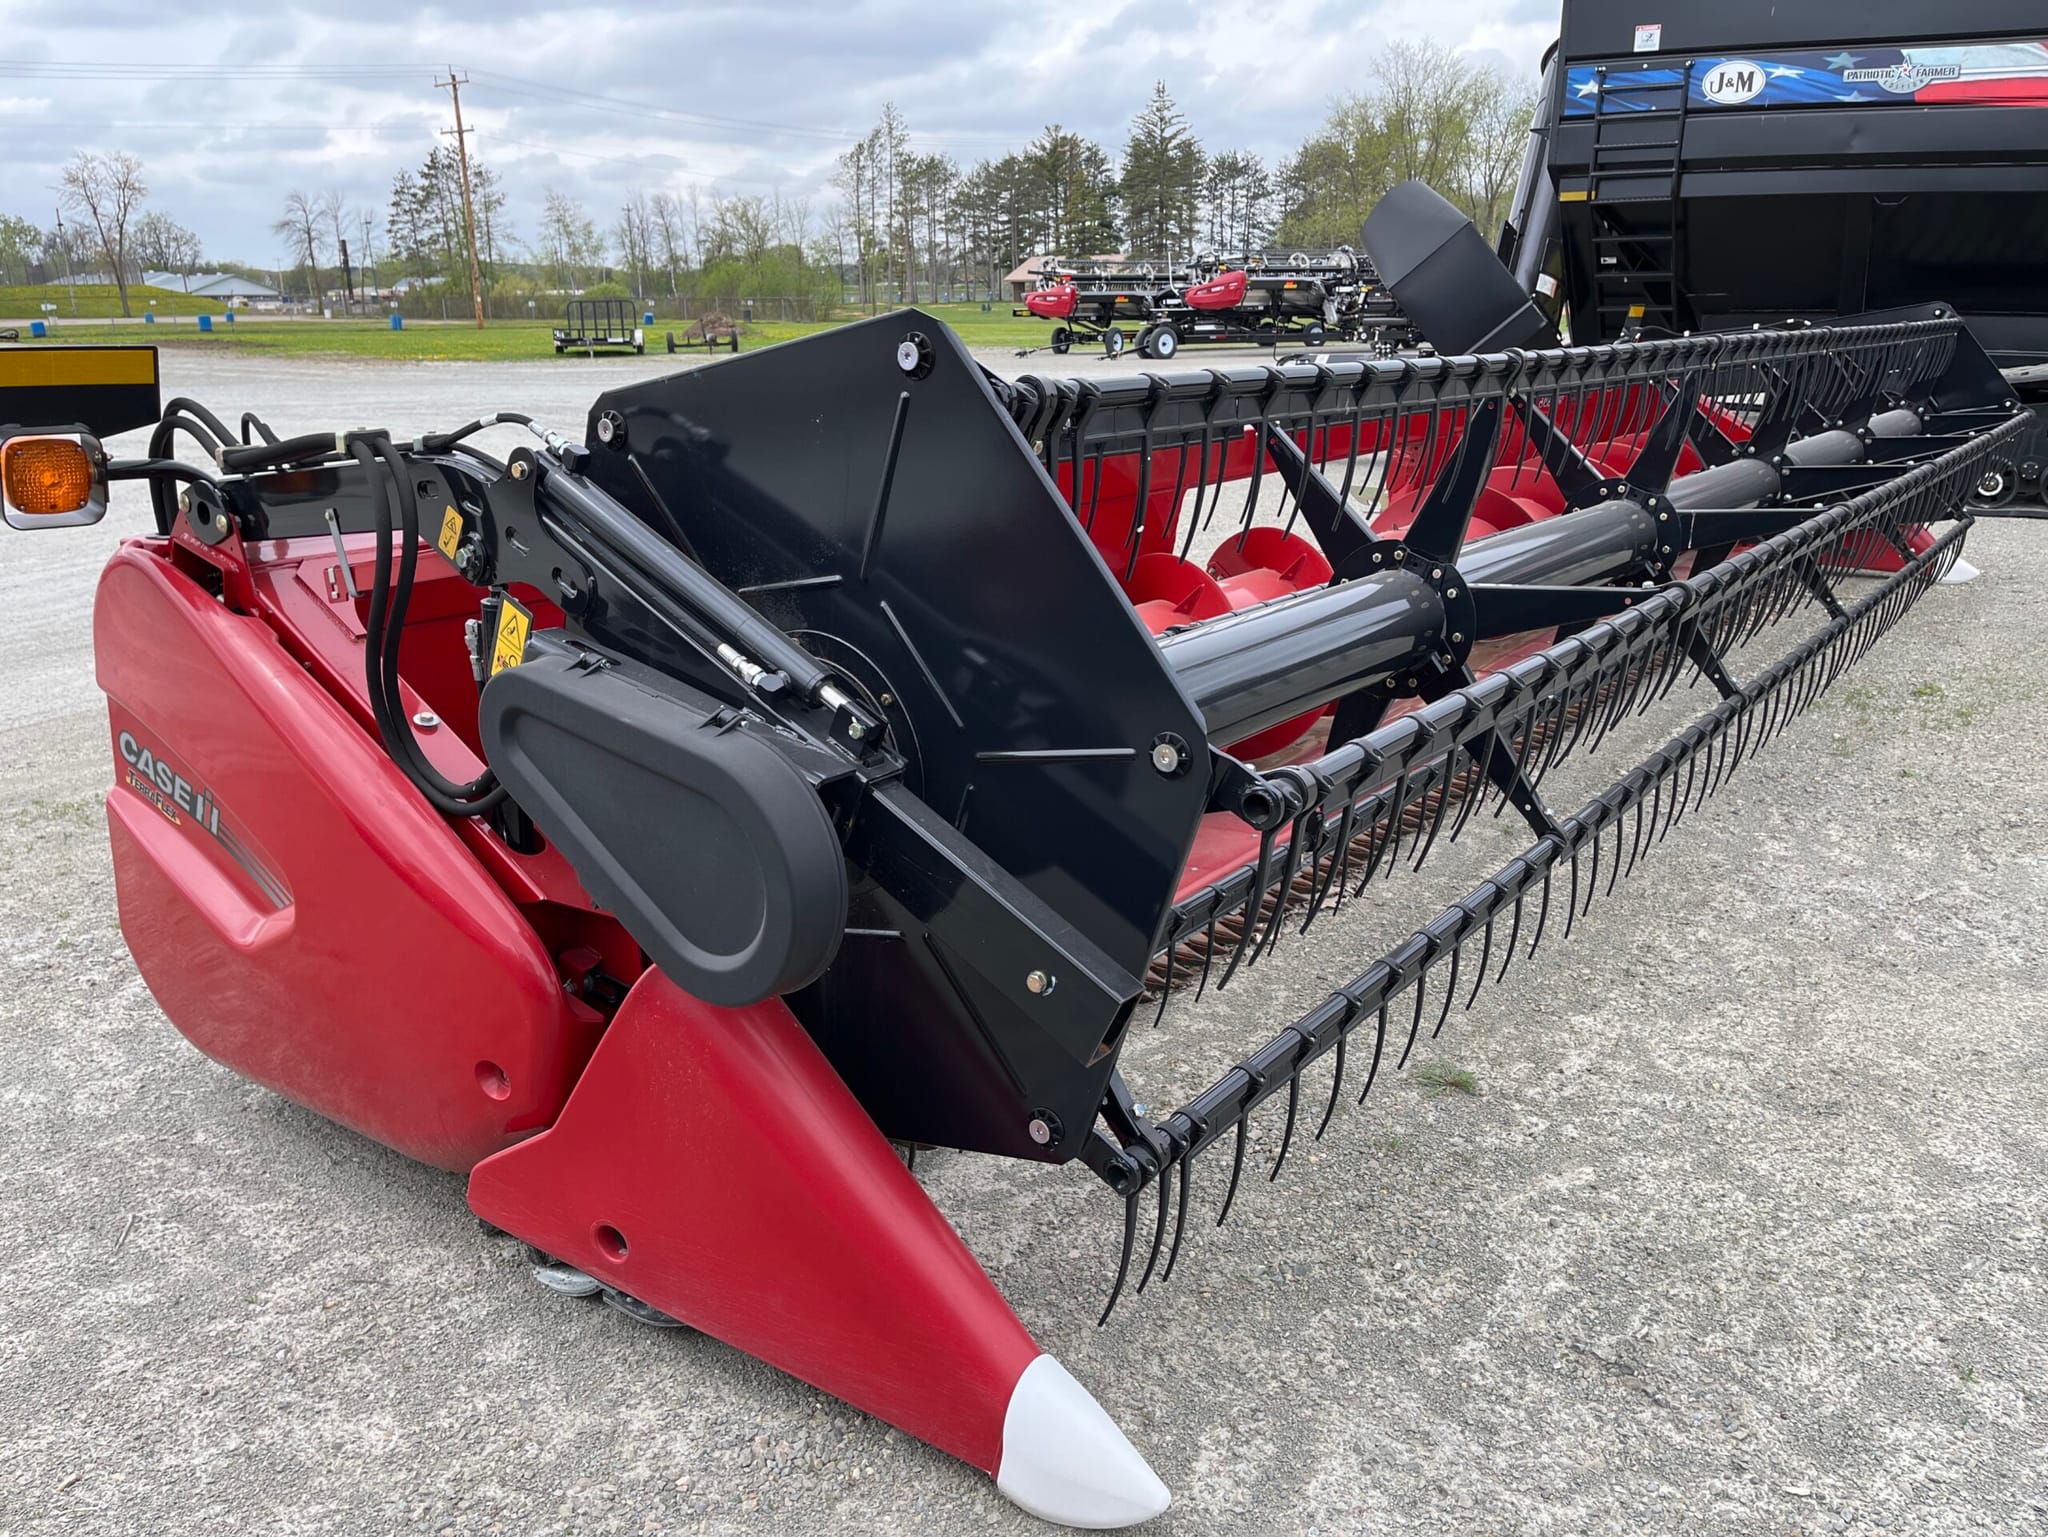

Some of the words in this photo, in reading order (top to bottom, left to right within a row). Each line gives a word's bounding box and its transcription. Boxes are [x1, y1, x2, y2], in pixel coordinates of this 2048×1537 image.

[1709, 70, 1756, 95] J&M
[1846, 69, 1896, 81] PATRIOTIC
[1916, 66, 1956, 78] FARMER
